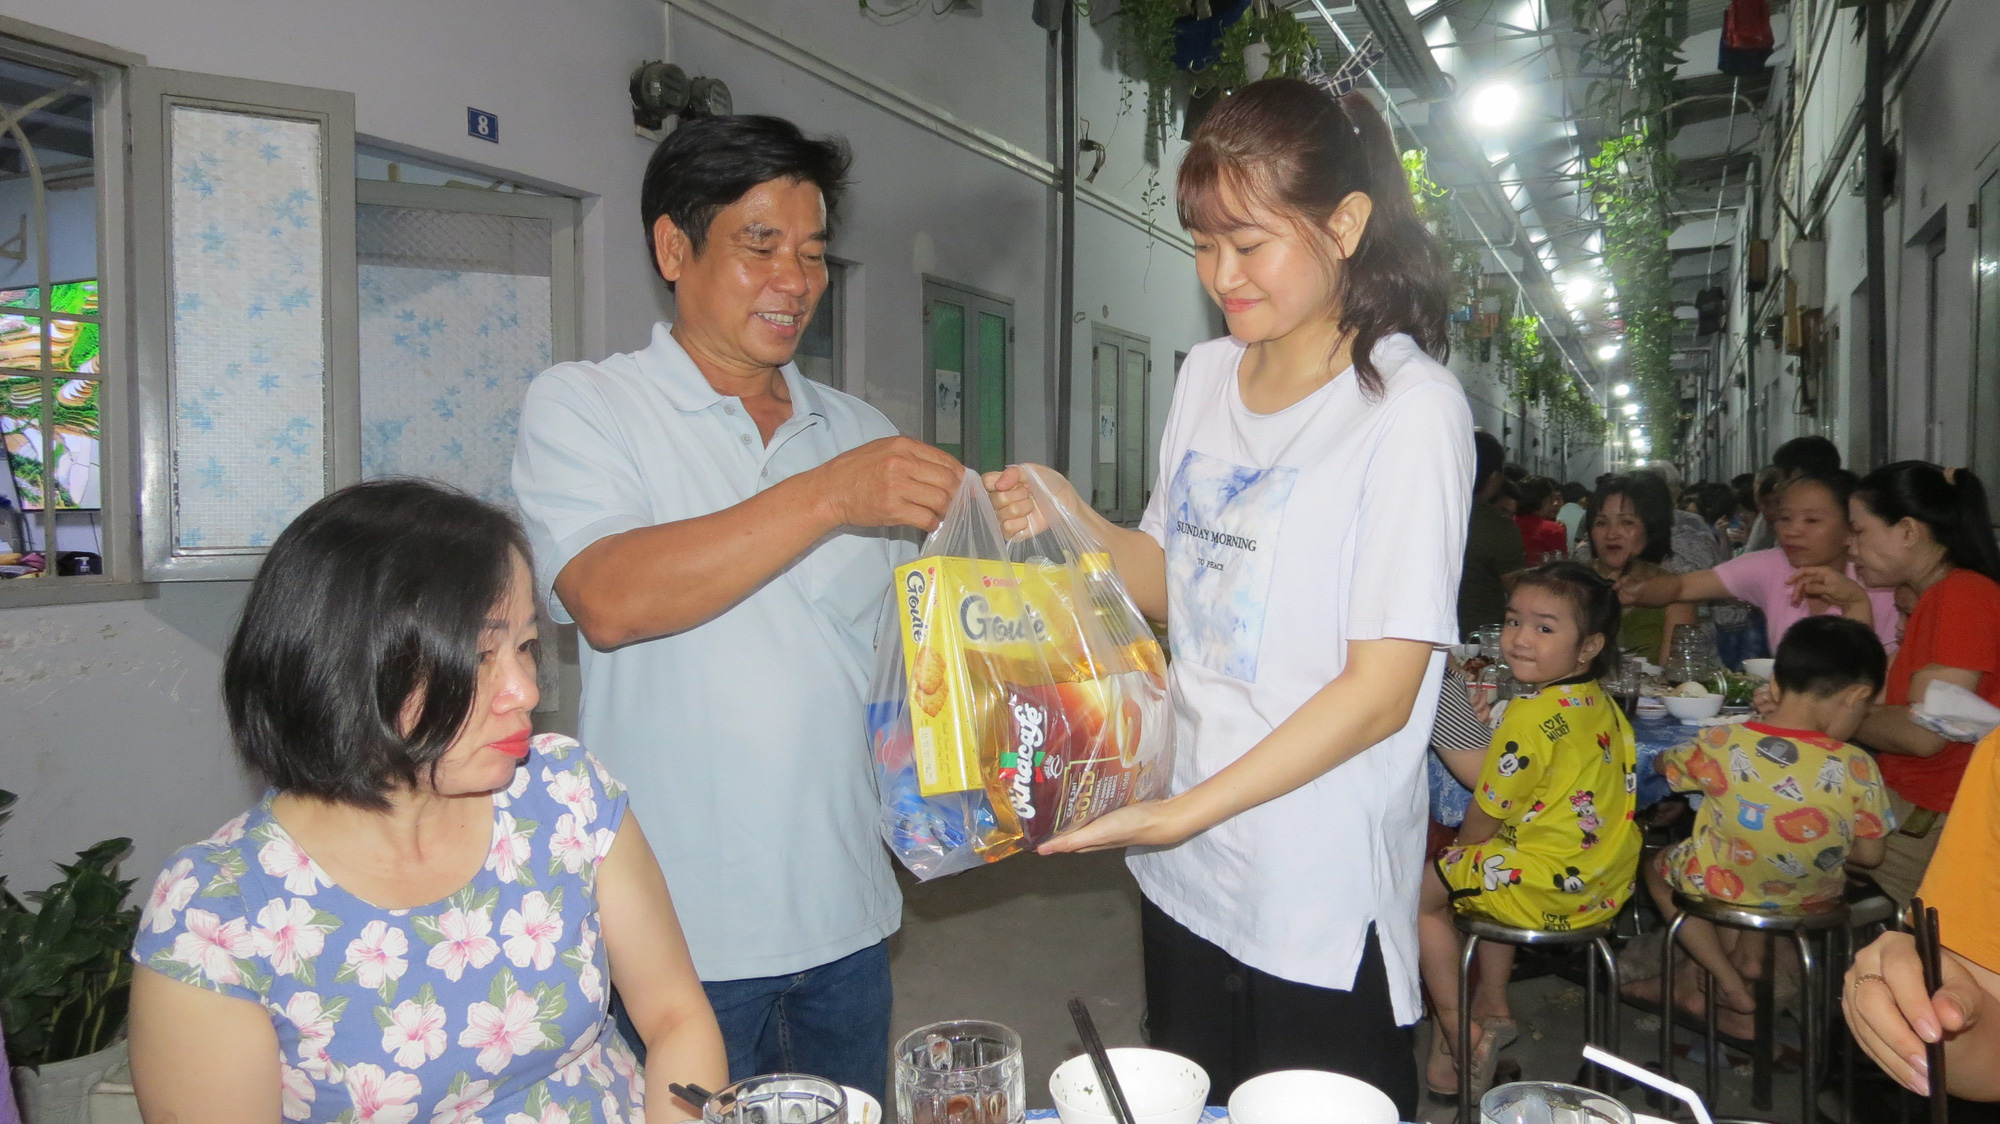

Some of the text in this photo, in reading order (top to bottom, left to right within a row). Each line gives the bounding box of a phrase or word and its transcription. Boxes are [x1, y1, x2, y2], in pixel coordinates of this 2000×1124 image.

[478, 115, 489, 136] 8
[1176, 520, 1257, 552] SUNDAY MORNING
[1197, 557, 1224, 571] TO PEACE
[1073, 771, 1096, 822] GOLD
[1091, 778, 1102, 813] ORIGINAL
